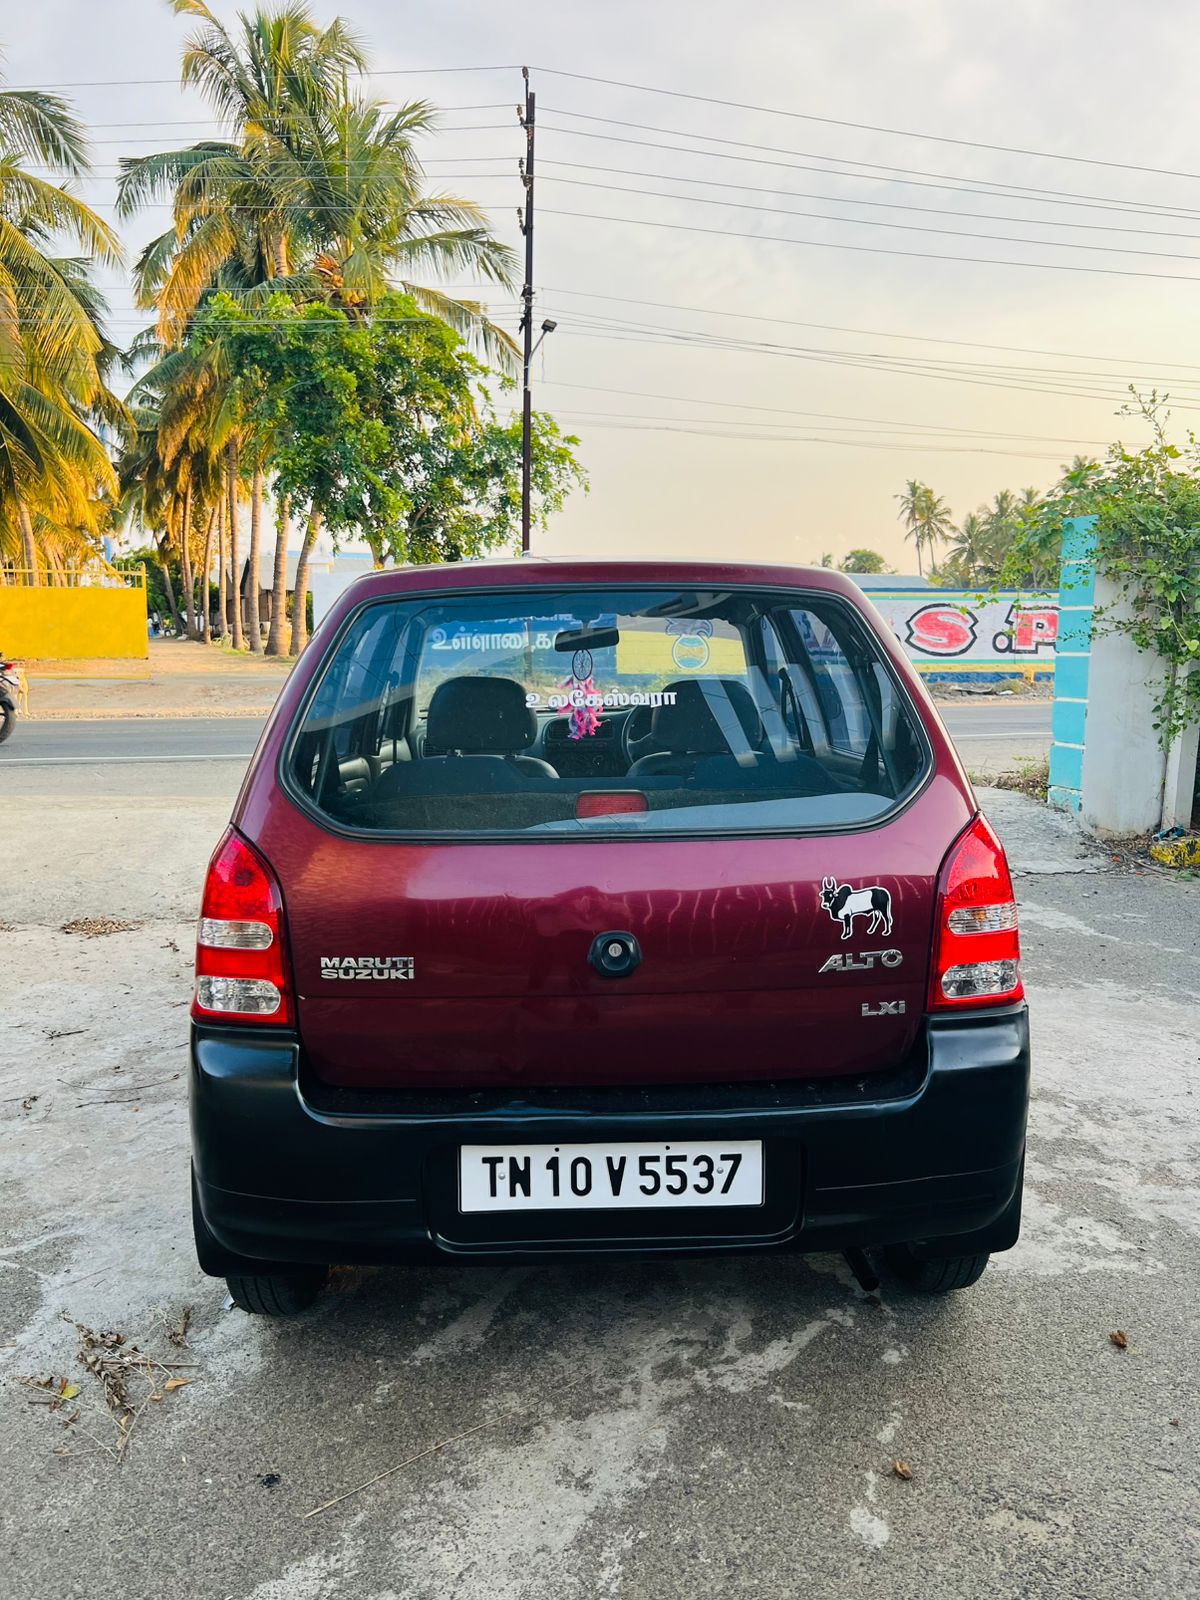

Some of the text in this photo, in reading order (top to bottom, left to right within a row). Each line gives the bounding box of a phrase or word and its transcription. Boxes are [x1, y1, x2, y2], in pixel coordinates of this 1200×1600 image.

[320, 956, 415, 968] MARUTI
[818, 948, 904, 974] ALTO
[320, 968, 415, 980] SUZUKI
[481, 1152, 743, 1198] TN 10 V 5537
